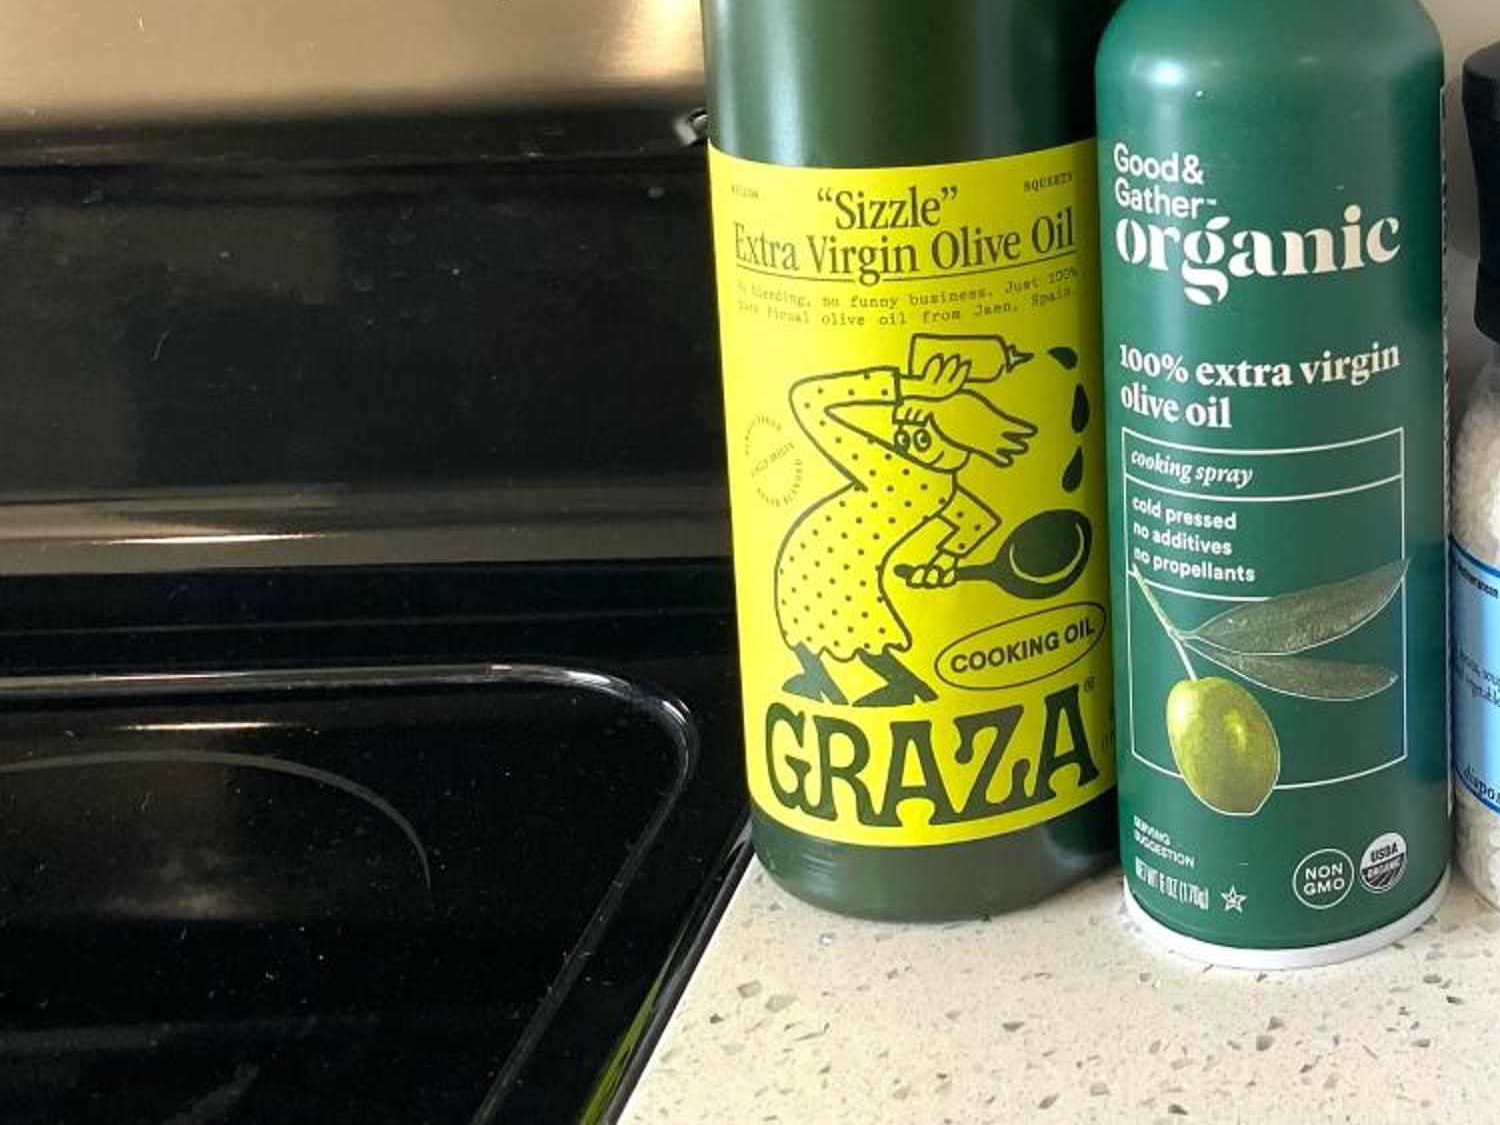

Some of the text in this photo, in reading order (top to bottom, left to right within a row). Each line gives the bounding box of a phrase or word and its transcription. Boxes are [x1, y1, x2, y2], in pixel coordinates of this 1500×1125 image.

[734, 205, 1074, 287] Extra Virgin Olive Oil
[1115, 204, 1401, 306] organic
[821, 312, 865, 326] olive
[879, 310, 907, 326] oil
[923, 308, 961, 323] from
[850, 295, 899, 310] funny
[1120, 341, 1401, 388] 100% extra virgin
[1120, 386, 1232, 429] olive oil
[1131, 450, 1253, 490] cooking spray
[1132, 496, 1237, 530] cold pressed
[1133, 522, 1233, 556] no additives
[1133, 546, 1256, 582] no propellants
[950, 617, 1096, 675] COOKING OIL
[765, 681, 1100, 827] GRAZA
[1370, 841, 1399, 863] USDA
[1303, 877, 1345, 896] GMO
[1305, 862, 1343, 881] NON
